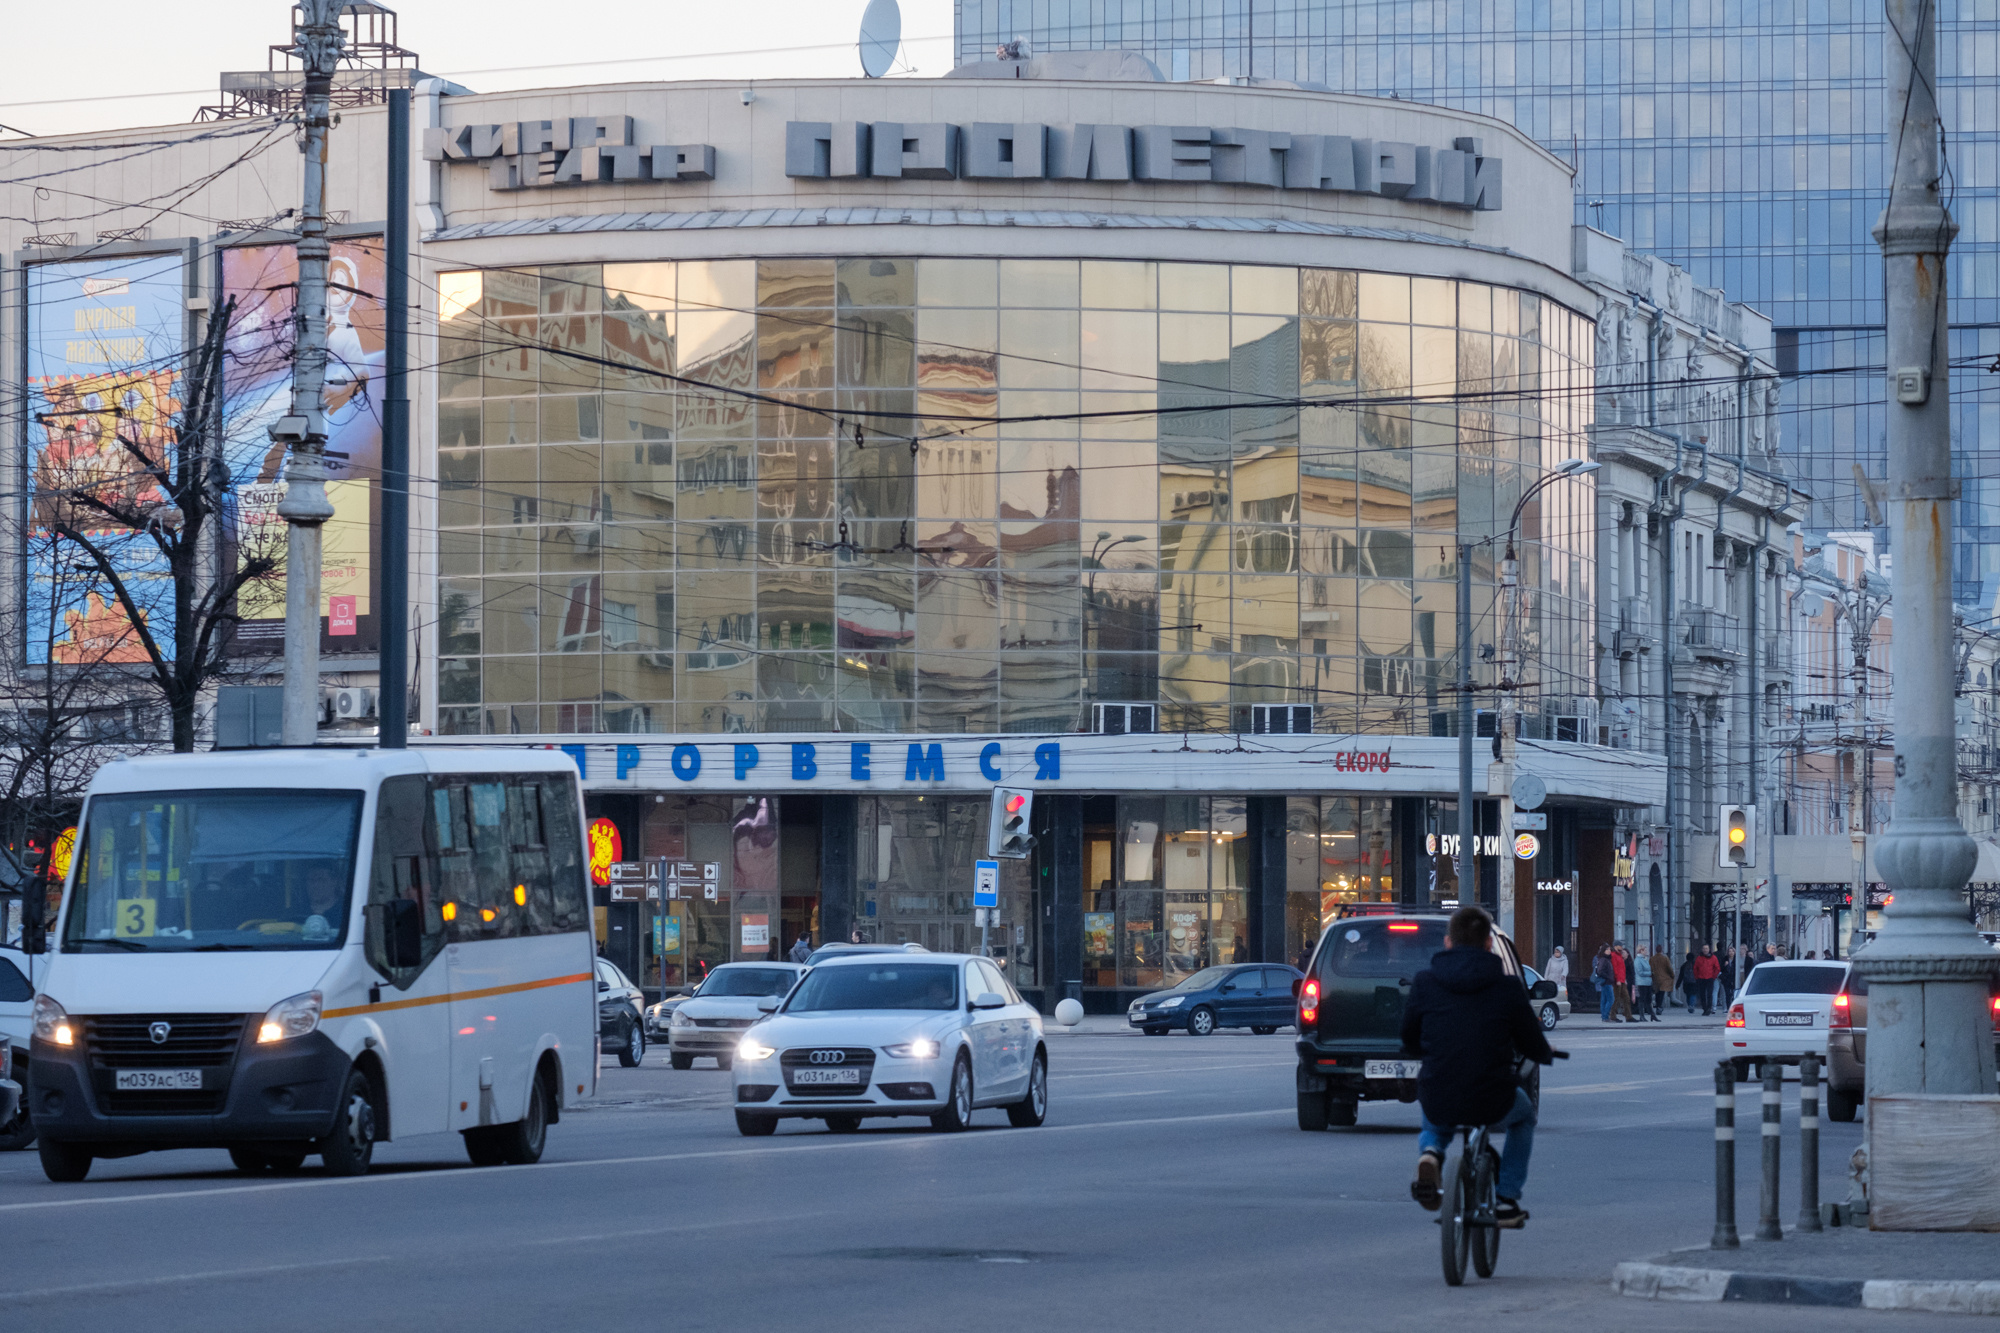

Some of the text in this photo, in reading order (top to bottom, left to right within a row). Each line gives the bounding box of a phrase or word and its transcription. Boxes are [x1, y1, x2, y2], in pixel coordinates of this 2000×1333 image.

[423, 115, 634, 161] КИНО
[480, 144, 716, 191] ТЕАТР
[786, 120, 1503, 211] ПРОЛЕТАРИЙ
[244, 491, 285, 505] Смотр
[561, 742, 1061, 782] ПРОРВЕМСЯ
[1335, 752, 1391, 773] СКОРО
[1441, 834, 1481, 856] БУРР
[1484, 835, 1502, 856] КИ
[1516, 843, 1535, 853] KING
[125, 904, 145, 935] 3
[119, 1073, 174, 1088] М039АС
[796, 1070, 857, 1083] К031АР 136
